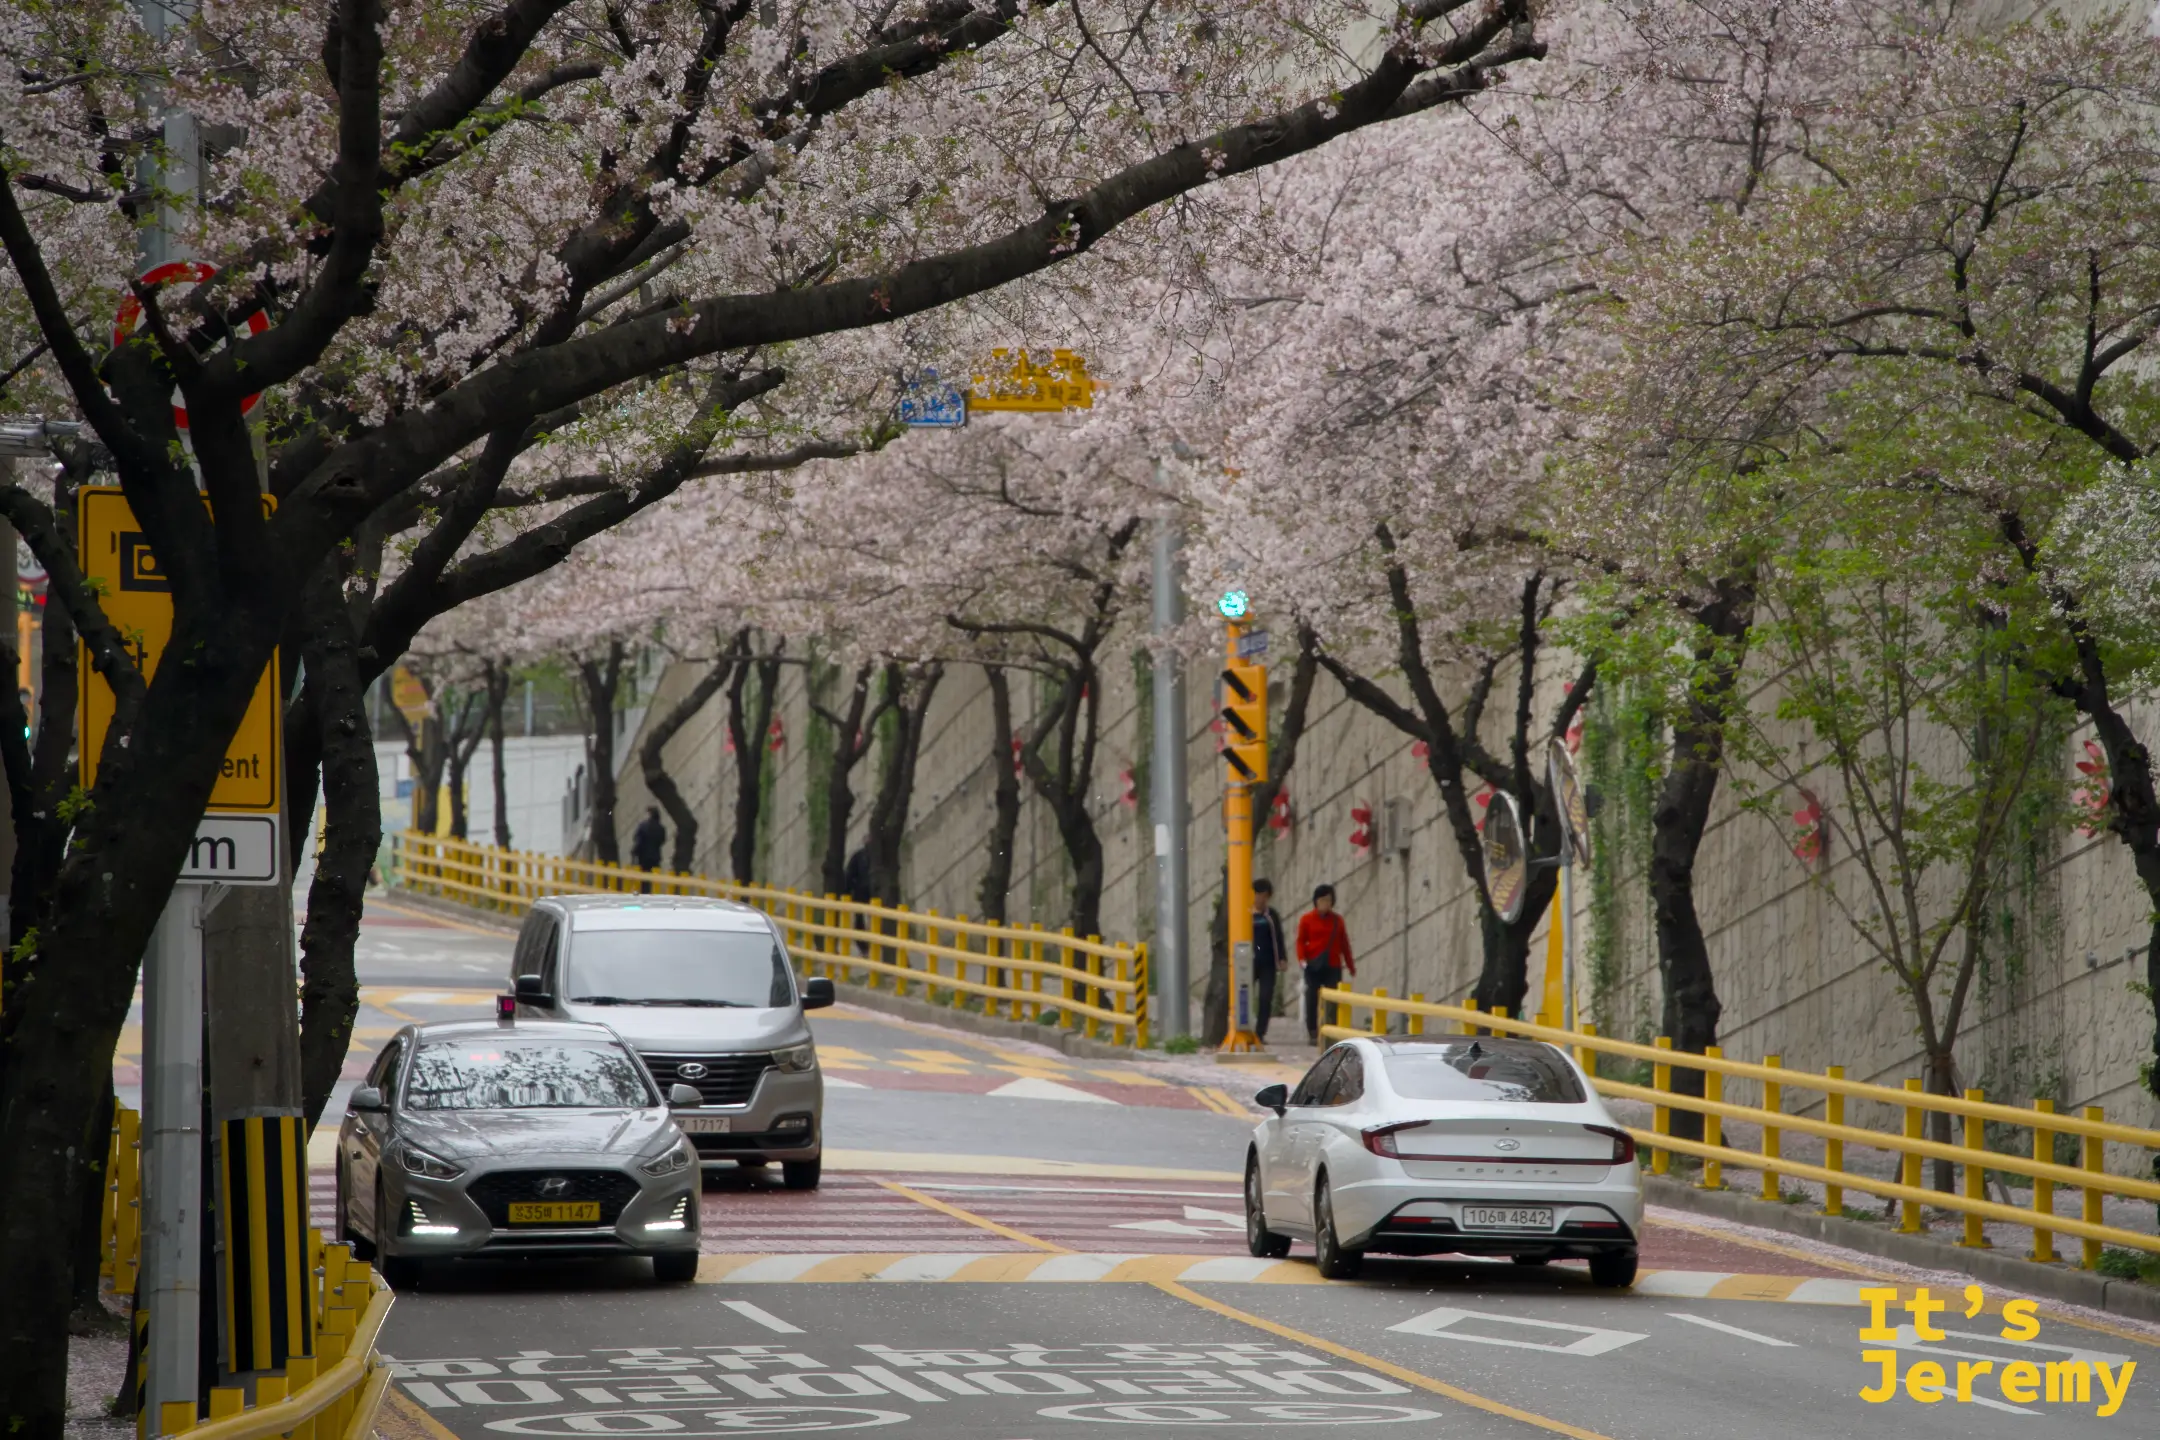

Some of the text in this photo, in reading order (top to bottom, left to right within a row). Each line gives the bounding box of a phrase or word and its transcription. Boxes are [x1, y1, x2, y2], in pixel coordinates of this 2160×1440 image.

[218, 754, 259, 778] ent
[692, 1118, 724, 1131] 1717
[557, 1204, 594, 1219] 1147
[1510, 1210, 1547, 1225] 4842
[853, 1343, 1332, 1366] 보호구역
[401, 1372, 892, 1408] 어린이
[913, 1369, 1413, 1396] 어린이
[562, 1408, 846, 1432] 30
[1102, 1404, 1384, 1421] 30
